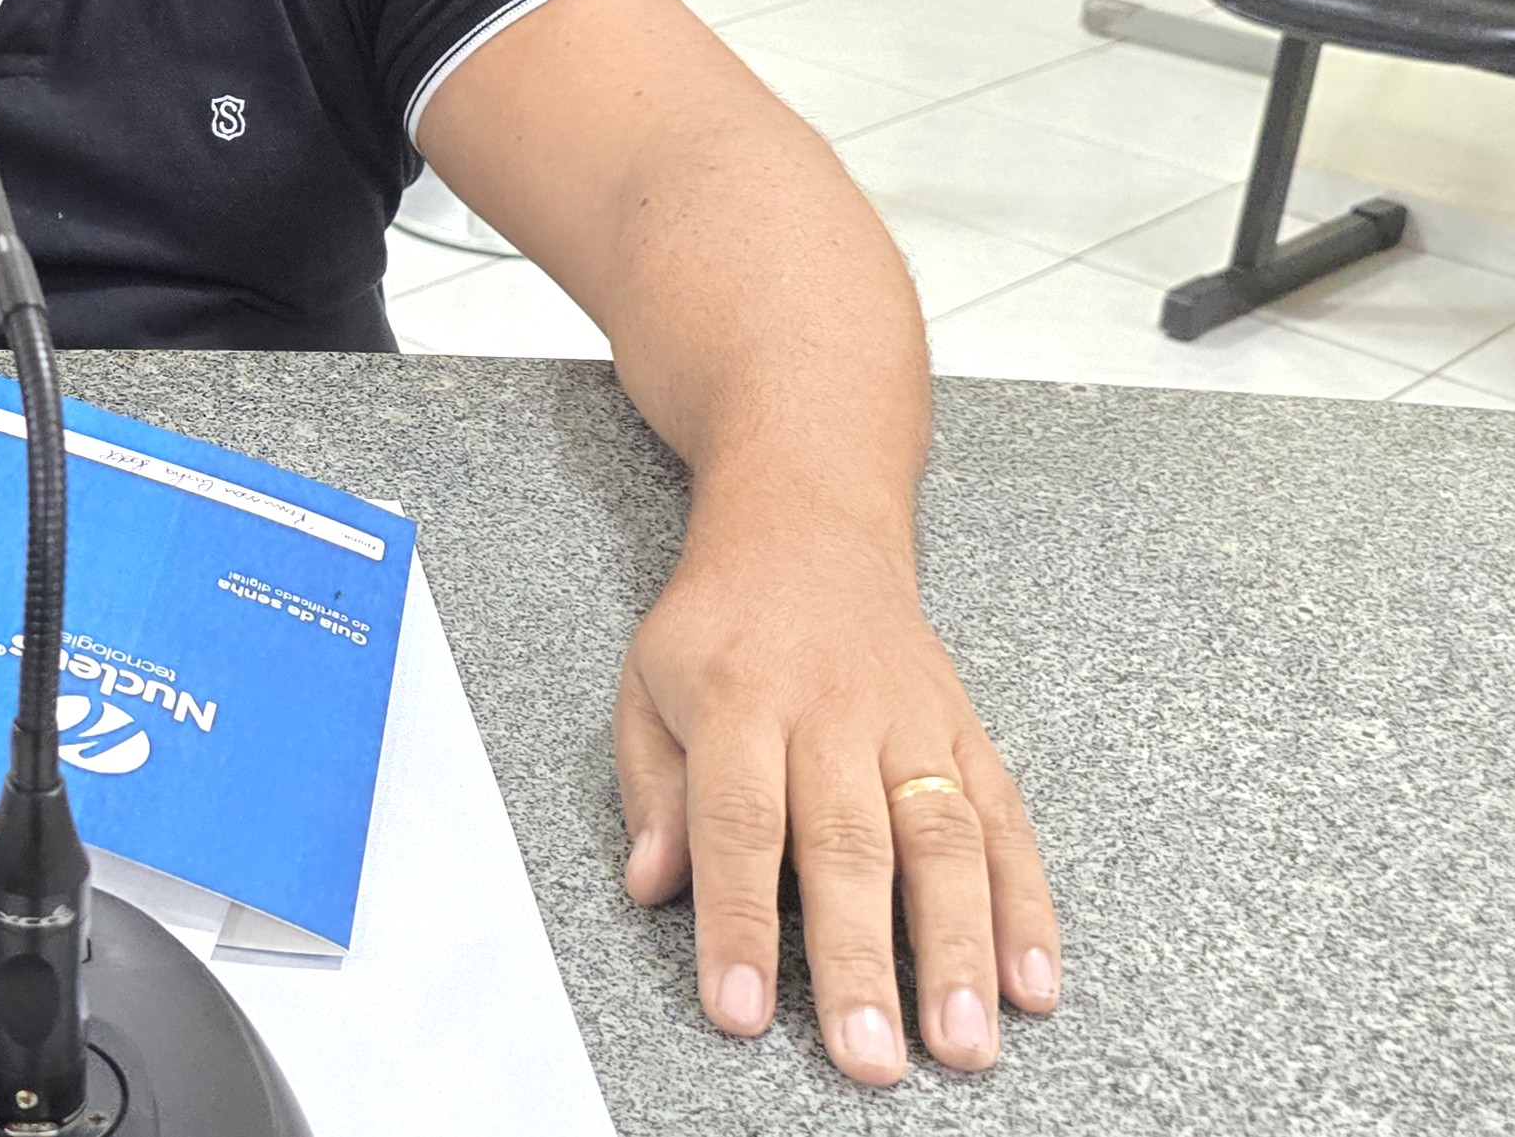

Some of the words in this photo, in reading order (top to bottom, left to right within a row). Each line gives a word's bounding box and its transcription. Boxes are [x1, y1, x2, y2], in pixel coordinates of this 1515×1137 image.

[217, 577, 283, 610] senha
[228, 570, 272, 593] digital
[274, 588, 349, 623] certificado
[287, 603, 315, 622] de
[318, 616, 368, 646] Guia
[351, 619, 371, 633] do
